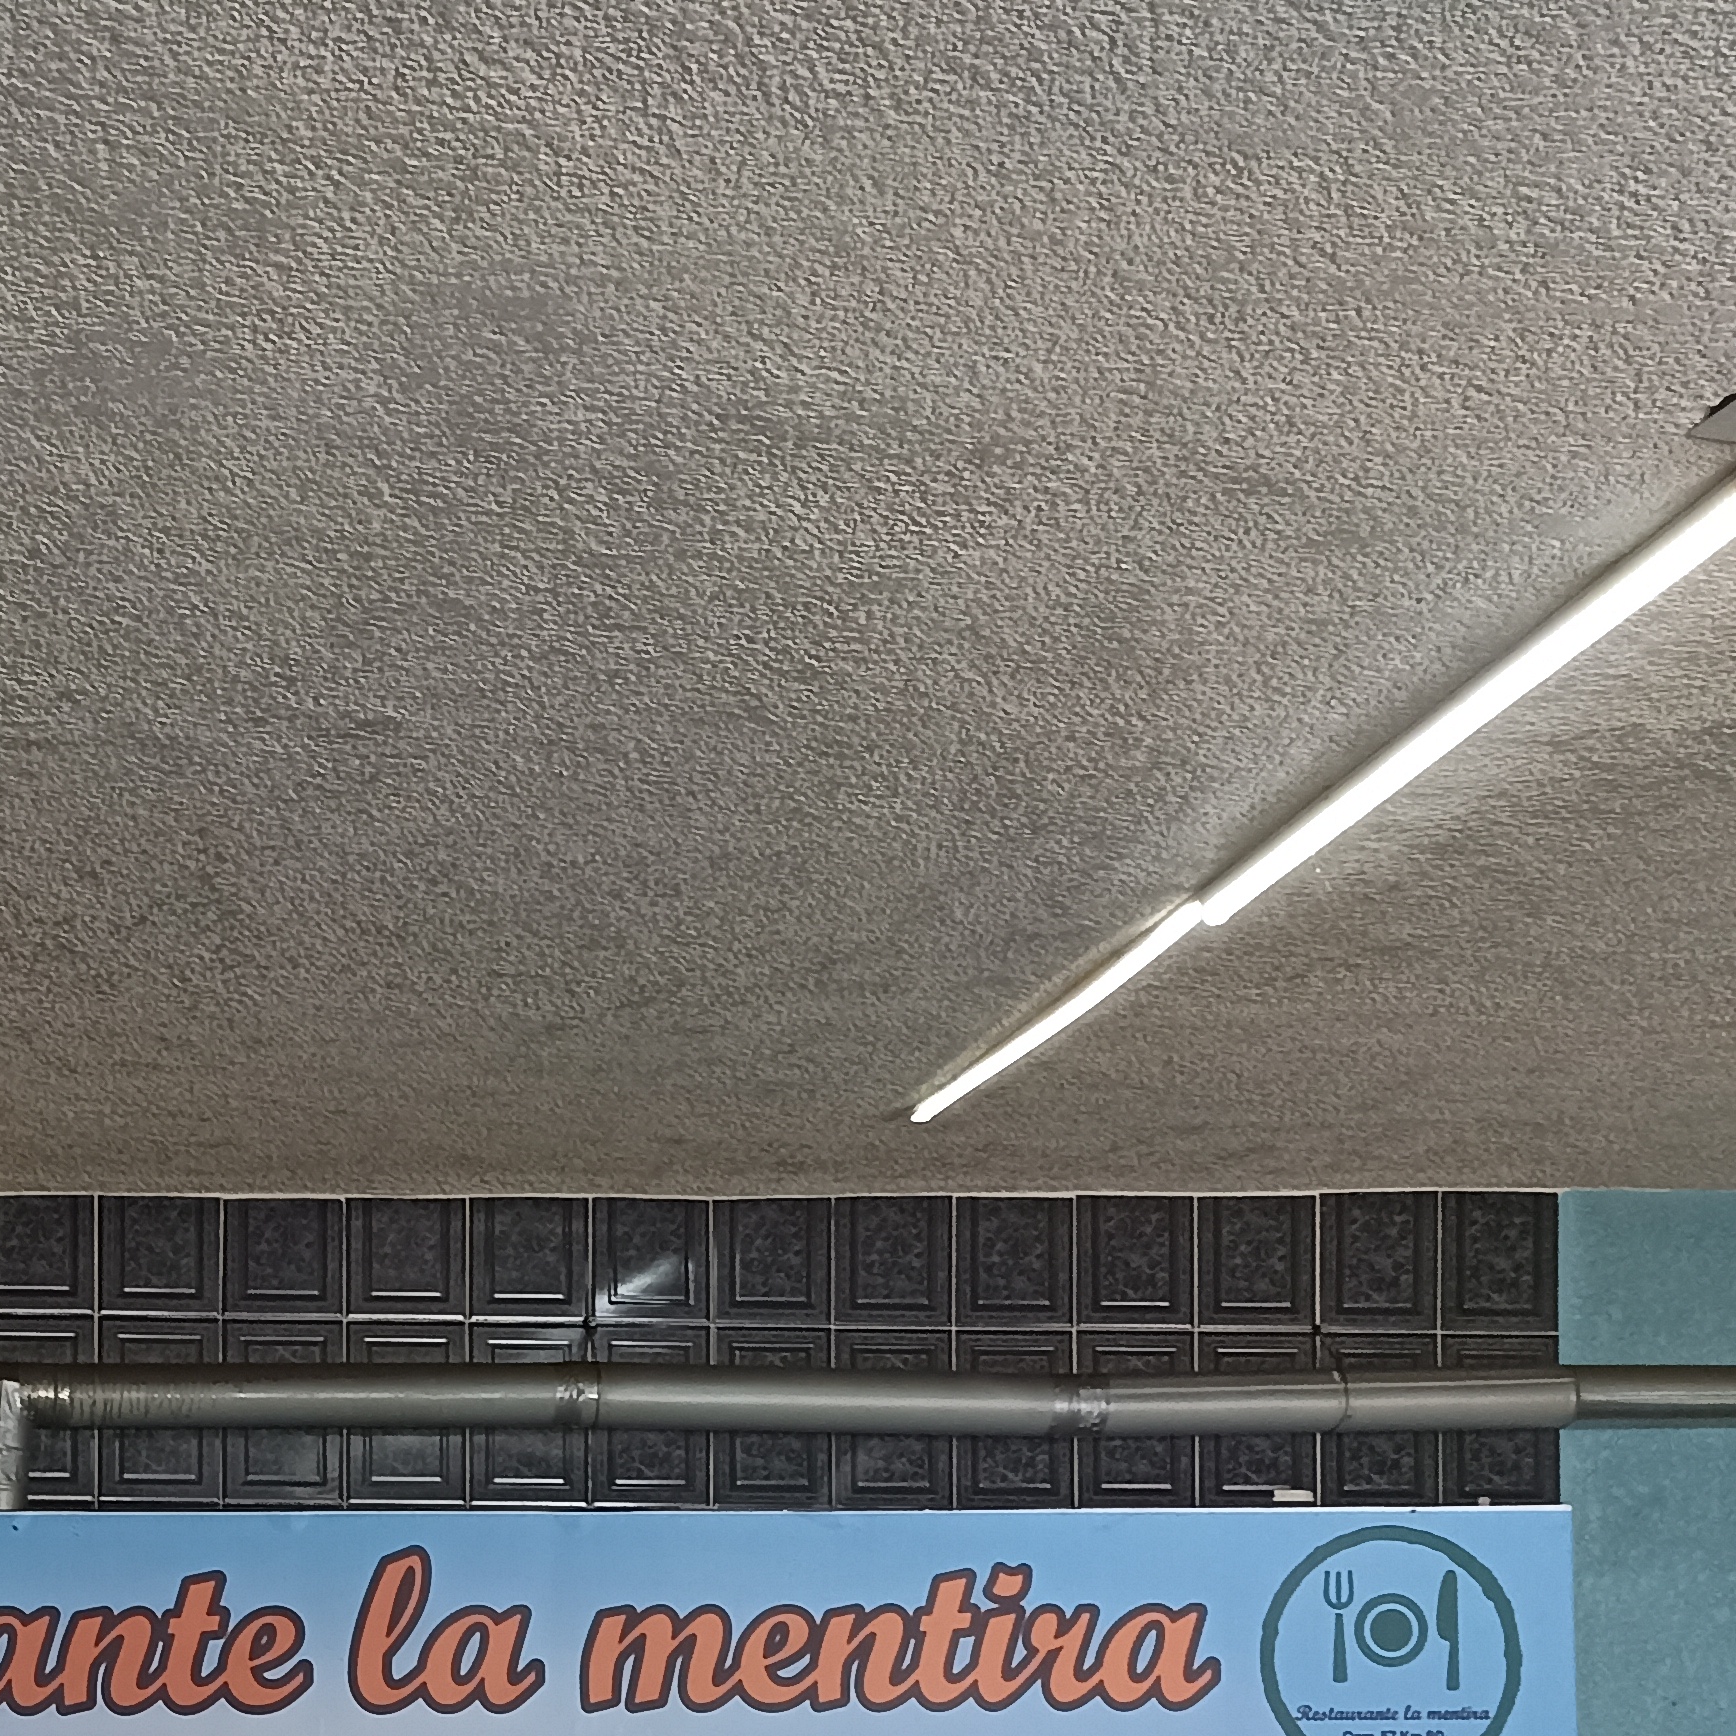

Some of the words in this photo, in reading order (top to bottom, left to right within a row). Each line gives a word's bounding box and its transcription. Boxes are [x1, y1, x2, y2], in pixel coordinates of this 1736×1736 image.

[347, 1545, 545, 1716] la
[579, 1562, 1221, 1713] mentira
[1294, 1704, 1399, 1721] Restaurante
[1403, 1704, 1422, 1721] la
[1427, 1706, 1491, 1721] mentira
